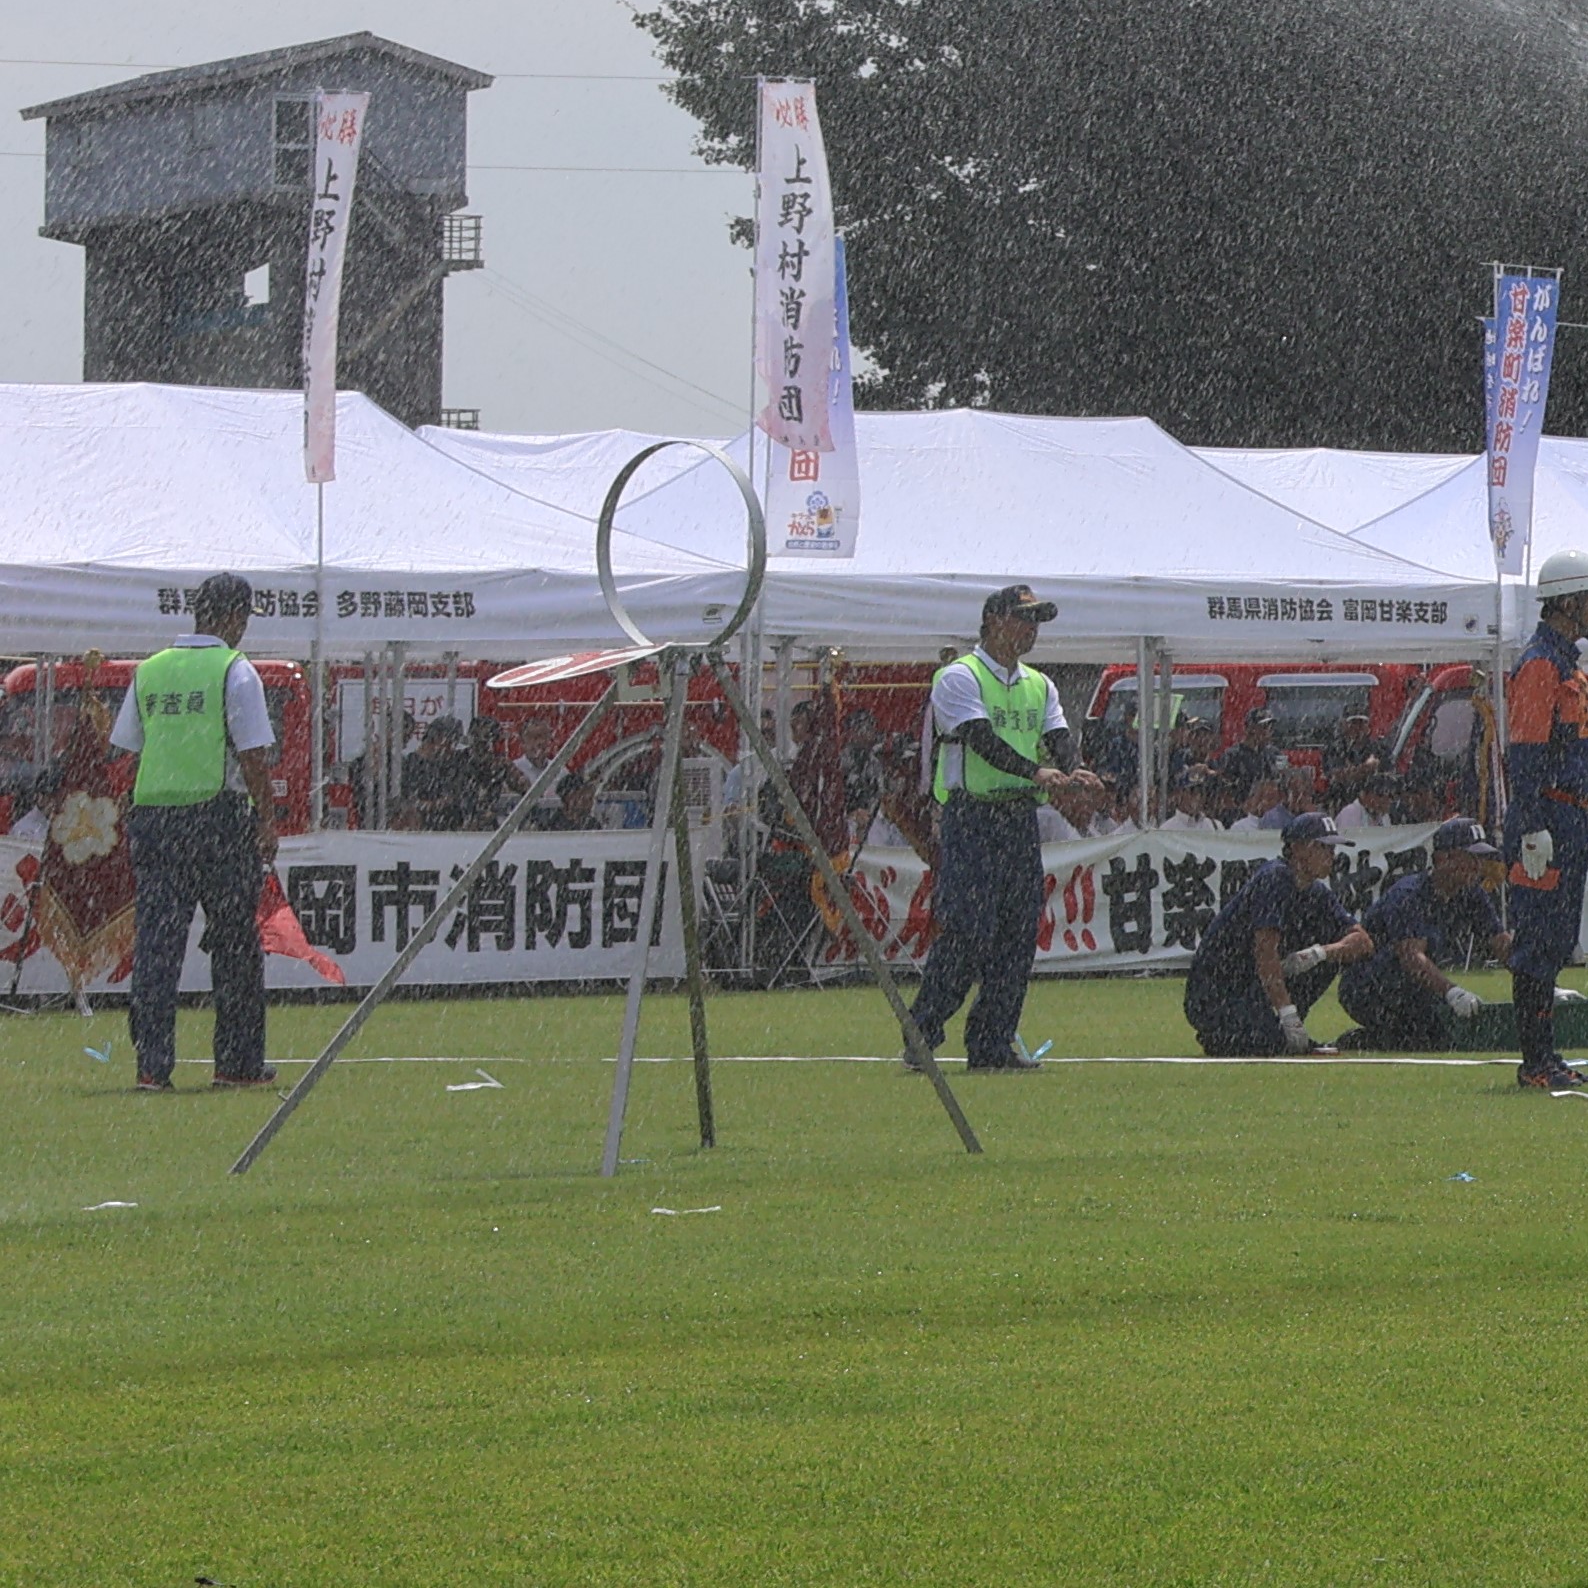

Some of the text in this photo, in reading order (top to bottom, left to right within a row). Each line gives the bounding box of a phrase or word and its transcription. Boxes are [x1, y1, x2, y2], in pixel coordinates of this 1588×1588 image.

[778, 144, 814, 425] 上野村消防団
[1491, 281, 1530, 487] 甘楽町消防団
[157, 588, 477, 618] 群馬防協会 多野藤岡支部
[1207, 596, 1448, 624] 群馬県消防協会 富岡甘楽支部
[199, 858, 669, 955] 岡市消防団
